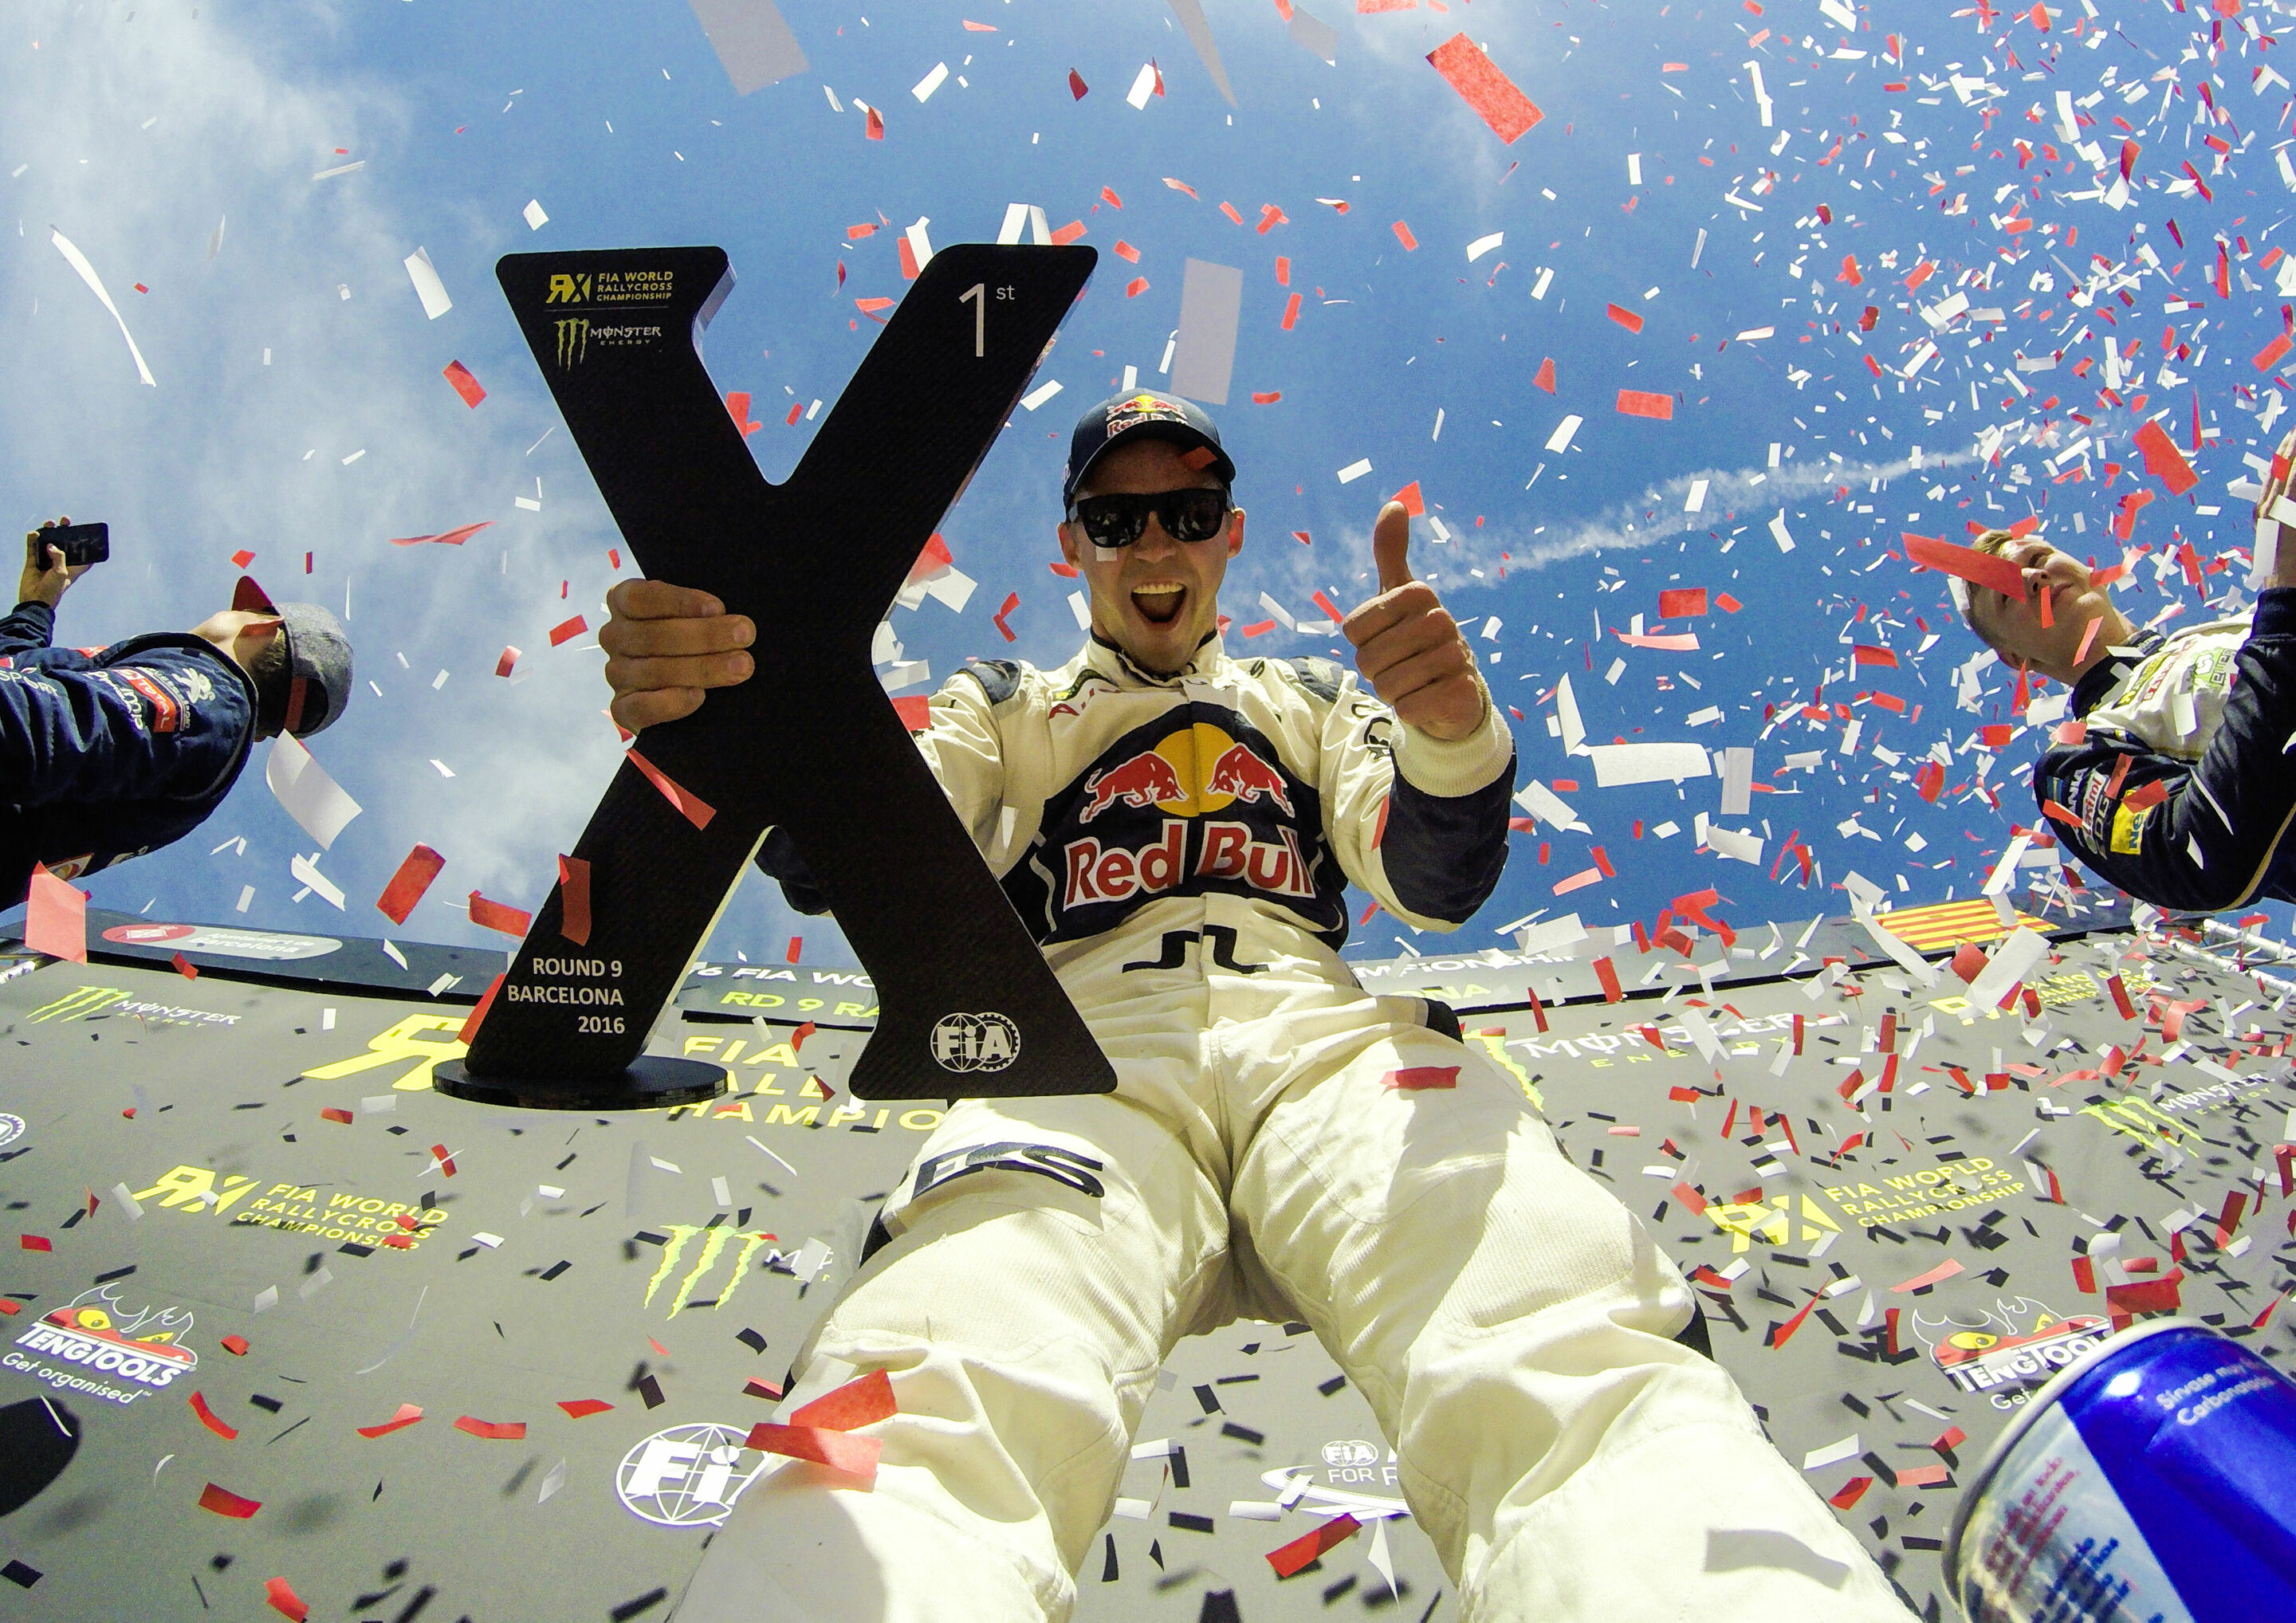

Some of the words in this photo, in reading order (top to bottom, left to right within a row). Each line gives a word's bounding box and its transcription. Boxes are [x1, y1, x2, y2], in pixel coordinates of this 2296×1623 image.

[598, 282, 673, 292] RALLYCROSS
[599, 273, 619, 282] FIA
[625, 271, 674, 281] WORLD
[596, 293, 672, 301] CHAMPIONSHIP
[1063, 819, 1188, 911] Red
[1196, 821, 1317, 899] Bull
[532, 957, 606, 977] ROUND
[611, 960, 623, 977] 9
[731, 967, 797, 981] FIA
[507, 984, 624, 1006] BARCELONA
[720, 991, 786, 1008] RD
[797, 998, 824, 1012] 9
[113, 1000, 242, 1024] MONSTER
[577, 1016, 625, 1035] 2016
[1520, 1012, 1818, 1059] MONSER
[683, 1036, 800, 1068] FIA
[1823, 1182, 1882, 1203] FIA
[1882, 1157, 1995, 1191] WORLD
[266, 1183, 317, 1203] FIA
[328, 1193, 449, 1224] WORLD
[1840, 1169, 2014, 1216] RALLYCRSS
[1857, 1181, 2026, 1228] CHAMPIONSHIP
[235, 1211, 421, 1252] CHAMPIONSP
[2, 1352, 41, 1373] Get
[15, 1322, 191, 1387] TENGTOOLS
[1945, 1323, 2109, 1393] TENGTOO
[1990, 1387, 2032, 1410] Get
[1327, 1468, 1376, 1483] FOR
